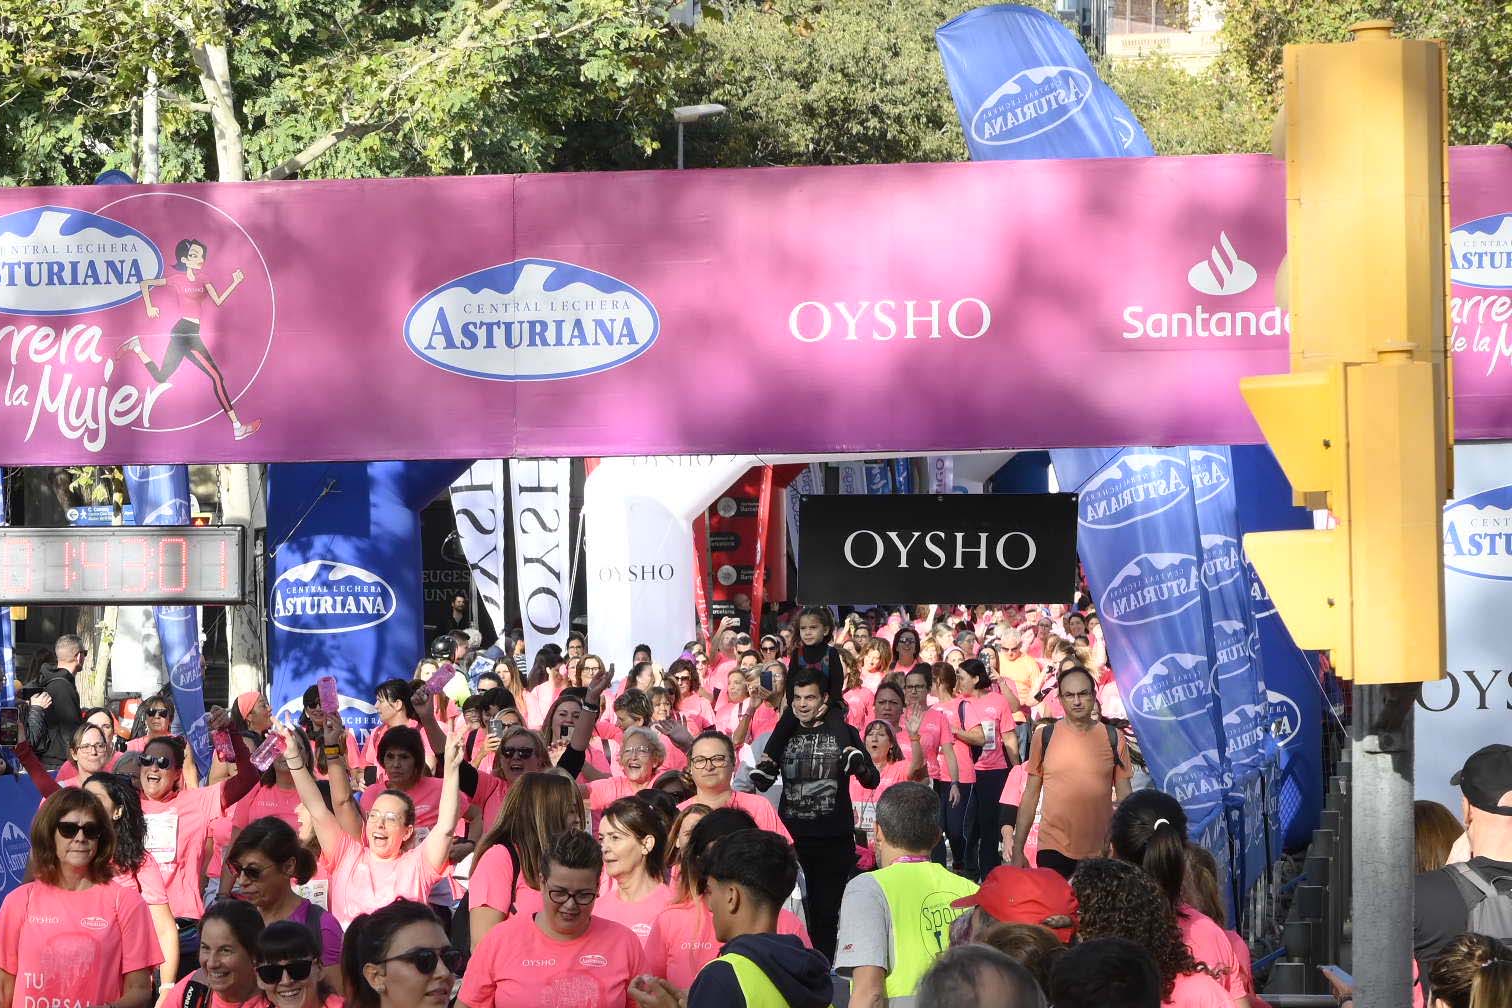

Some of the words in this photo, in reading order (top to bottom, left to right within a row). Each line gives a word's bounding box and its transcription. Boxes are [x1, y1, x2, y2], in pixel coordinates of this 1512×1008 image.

[66, 242, 138, 254] LECHERA
[463, 301, 540, 315] CENTRAL
[549, 299, 632, 312] LECHERA
[424, 305, 640, 351] ASTURIANA
[787, 297, 991, 342] OYSHO
[5, 368, 29, 407] la
[24, 358, 173, 452] Mujer
[843, 529, 1037, 571] OYSHO
[599, 563, 674, 583] OYSHO
[333, 585, 382, 593] LECHERA
[274, 590, 387, 617] ASTURIANA
[522, 958, 556, 967] OYSHO
[24, 972, 44, 990] TU
